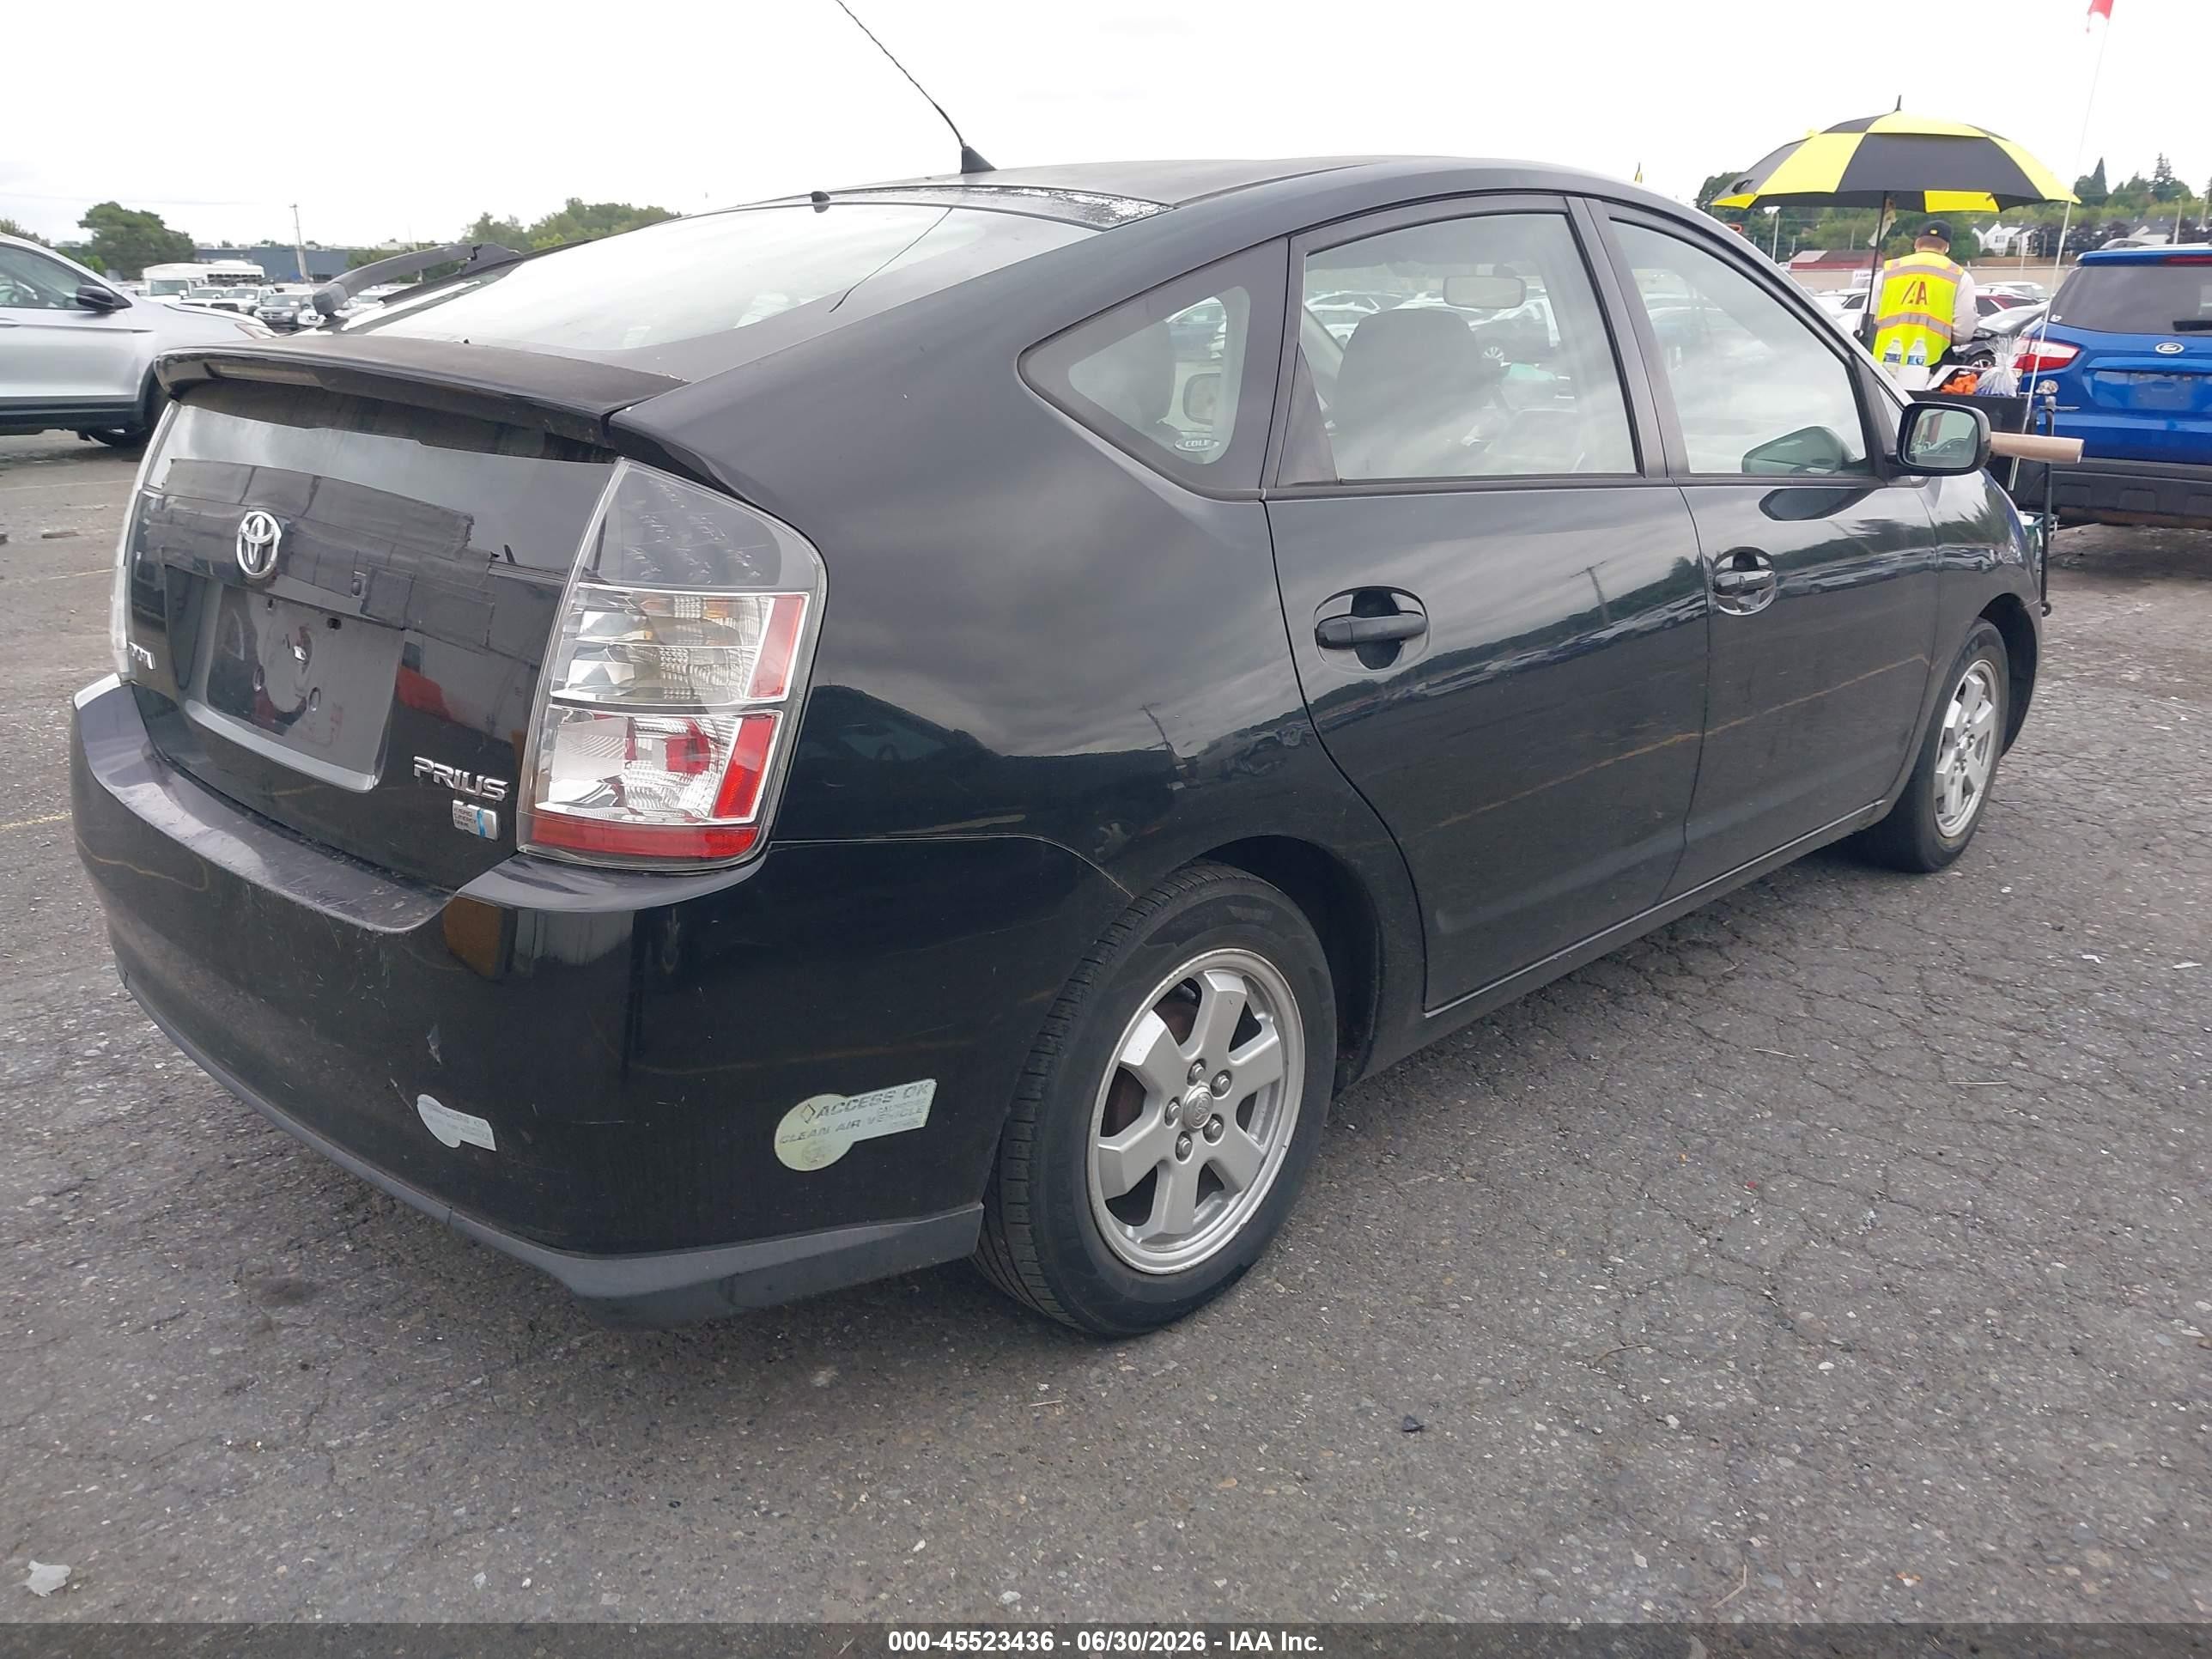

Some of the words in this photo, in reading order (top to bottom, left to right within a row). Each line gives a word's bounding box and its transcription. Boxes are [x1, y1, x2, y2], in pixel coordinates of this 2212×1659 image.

[413, 756, 509, 802] PRIUS
[815, 1090, 896, 1119] ACCESS
[902, 1084, 929, 1099] OK
[780, 1126, 831, 1144] CLEAN
[835, 1119, 862, 1132] AIR
